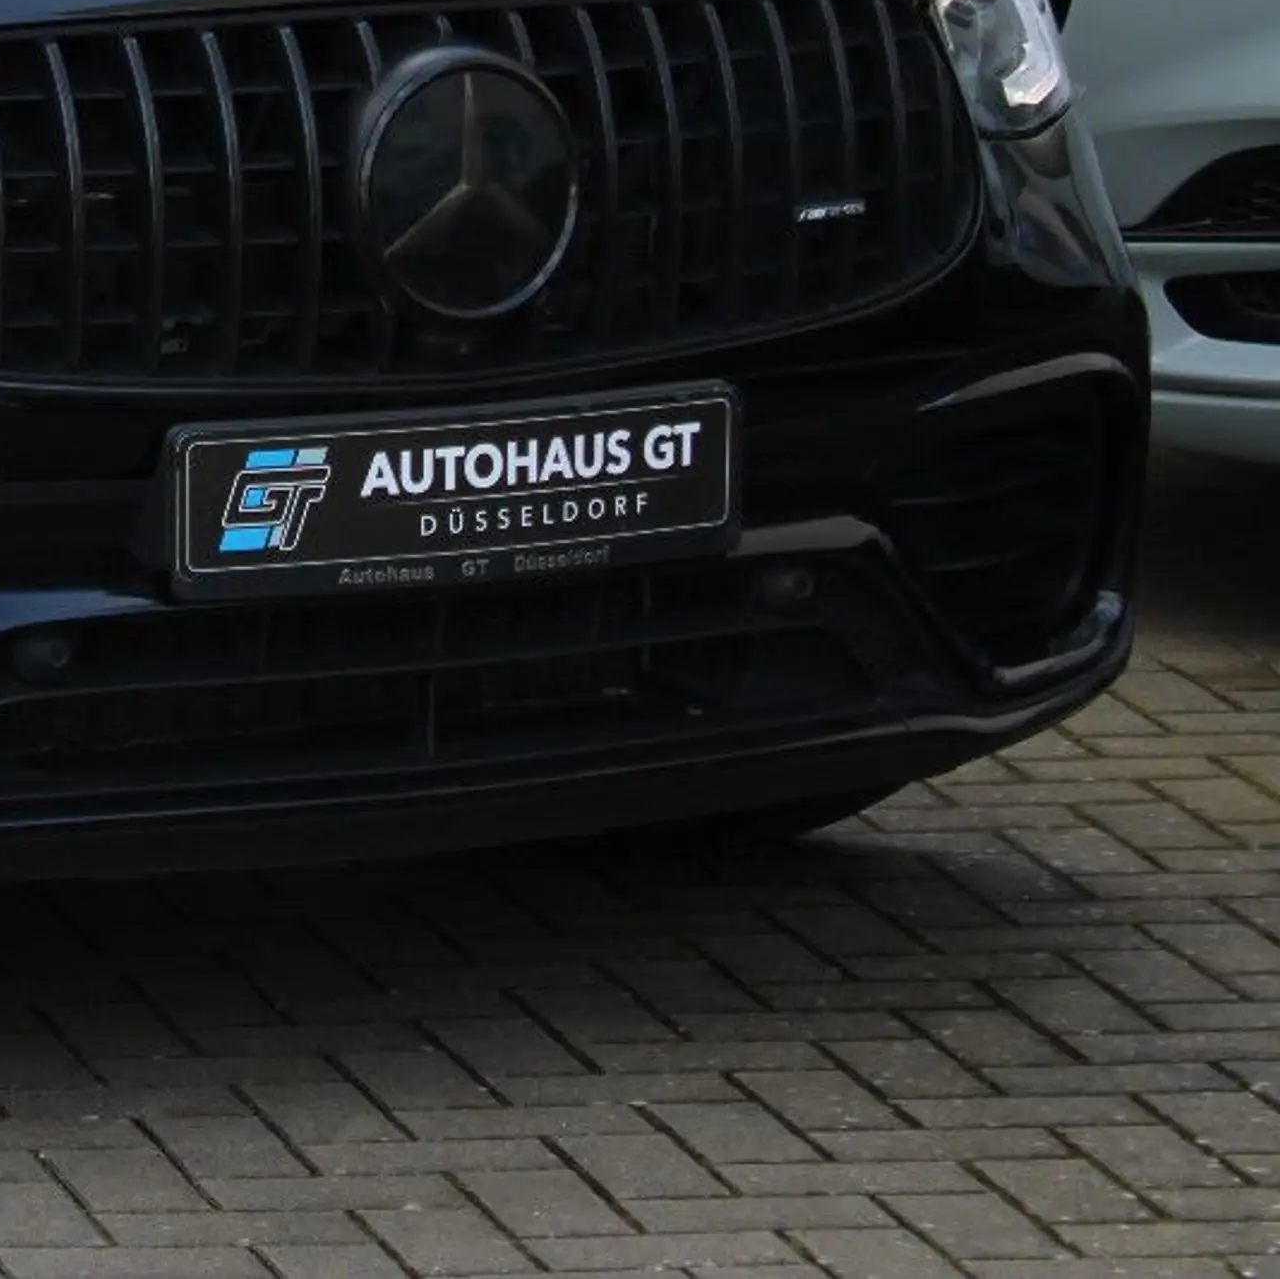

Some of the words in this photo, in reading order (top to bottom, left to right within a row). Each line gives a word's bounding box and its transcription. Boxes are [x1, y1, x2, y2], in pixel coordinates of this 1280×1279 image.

[359, 428, 632, 498] AUTOHAUS
[643, 421, 702, 471] GT
[419, 491, 649, 537] DÜSSELDORF
[338, 565, 436, 586] Autohaus
[461, 558, 490, 577] GT
